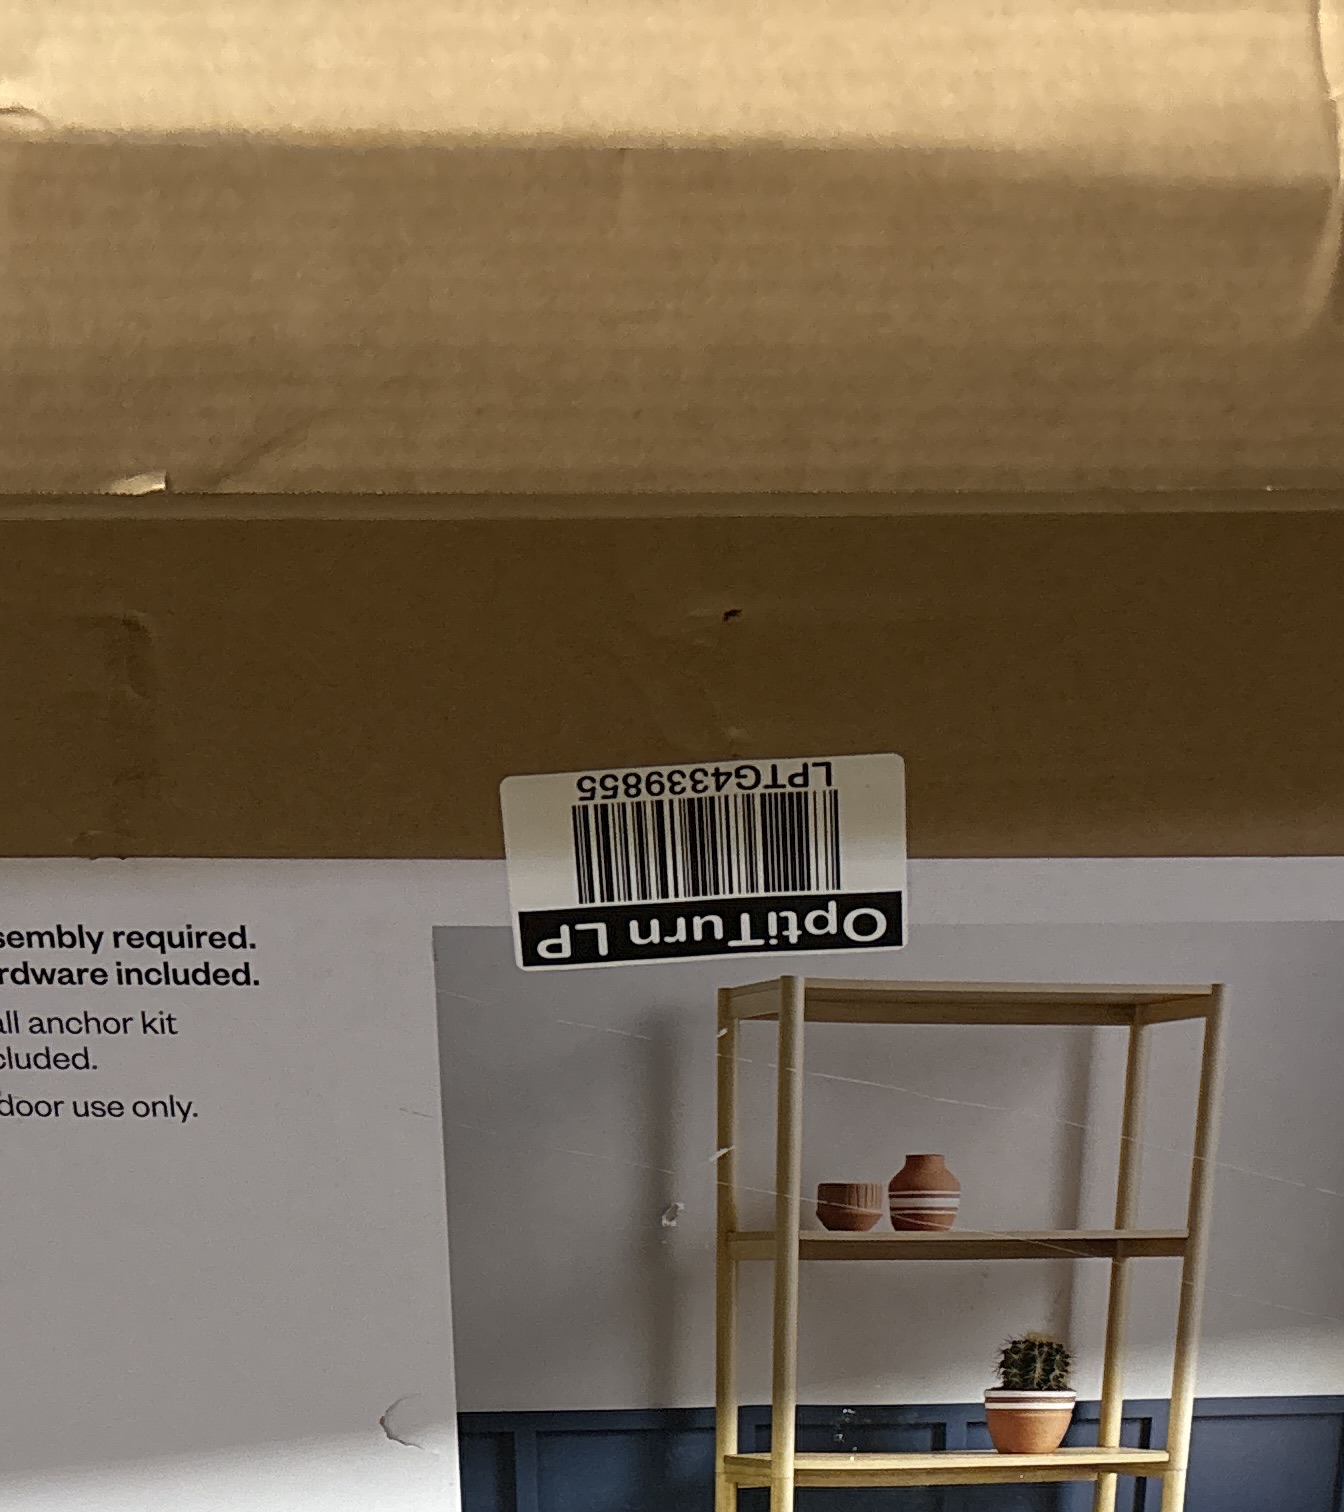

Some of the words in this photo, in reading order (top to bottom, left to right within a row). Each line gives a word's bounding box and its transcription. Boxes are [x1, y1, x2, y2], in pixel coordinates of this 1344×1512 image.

[576, 761, 833, 801] LPTG4339855
[113, 924, 256, 954] required.
[629, 901, 887, 947] OptiTurn
[536, 922, 609, 960] LP
[116, 961, 259, 986] included.
[28, 1010, 133, 1035] anchor
[141, 1010, 178, 1035] kit
[72, 1100, 124, 1118] use
[132, 1094, 198, 1123] only.
